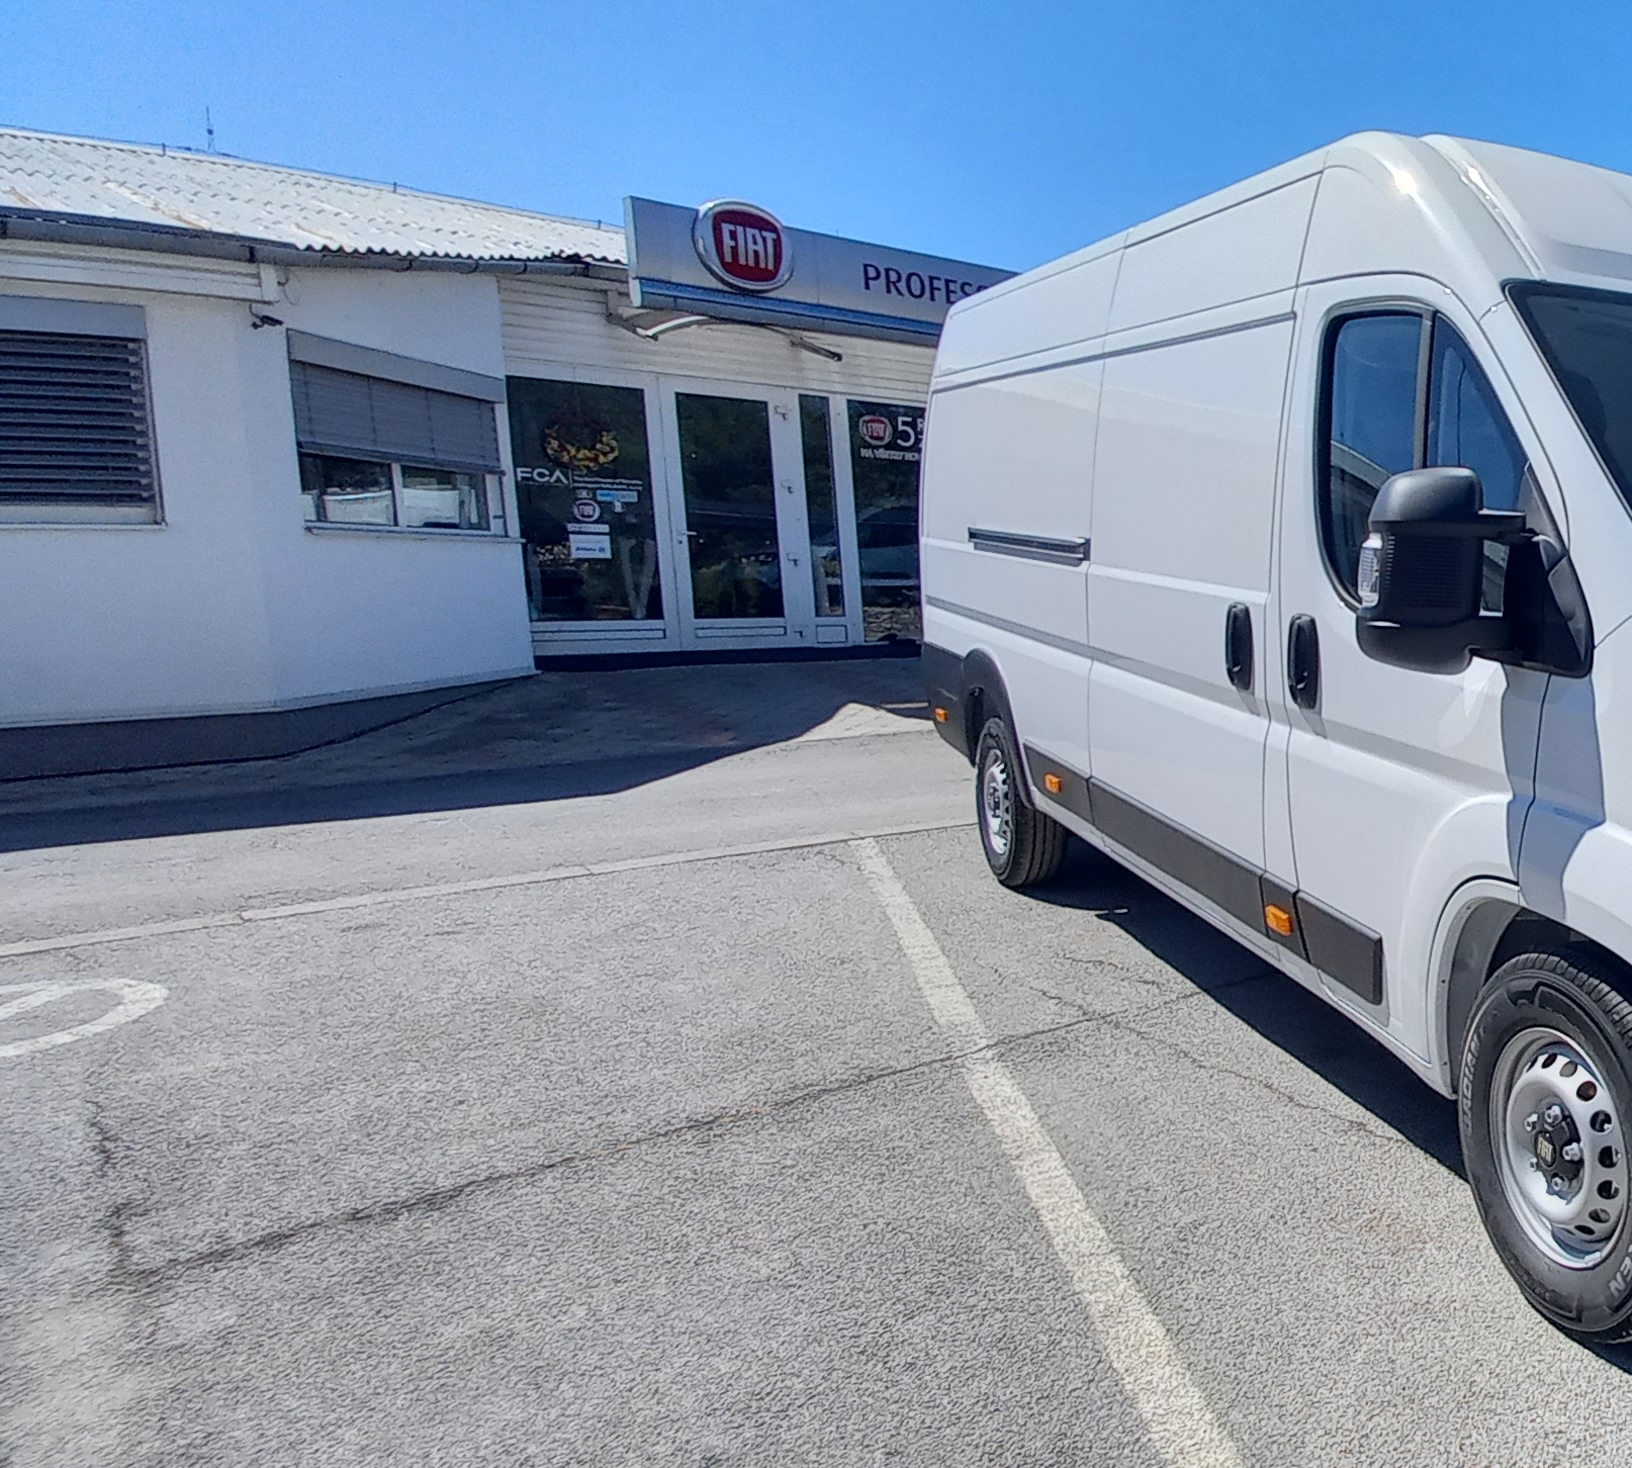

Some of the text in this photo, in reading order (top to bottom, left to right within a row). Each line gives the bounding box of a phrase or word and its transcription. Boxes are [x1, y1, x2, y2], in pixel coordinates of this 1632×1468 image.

[721, 222, 777, 272] FIAT
[896, 416, 916, 447] 5
[516, 467, 569, 485] FCA
[1537, 1133, 1554, 1165] FIAT
